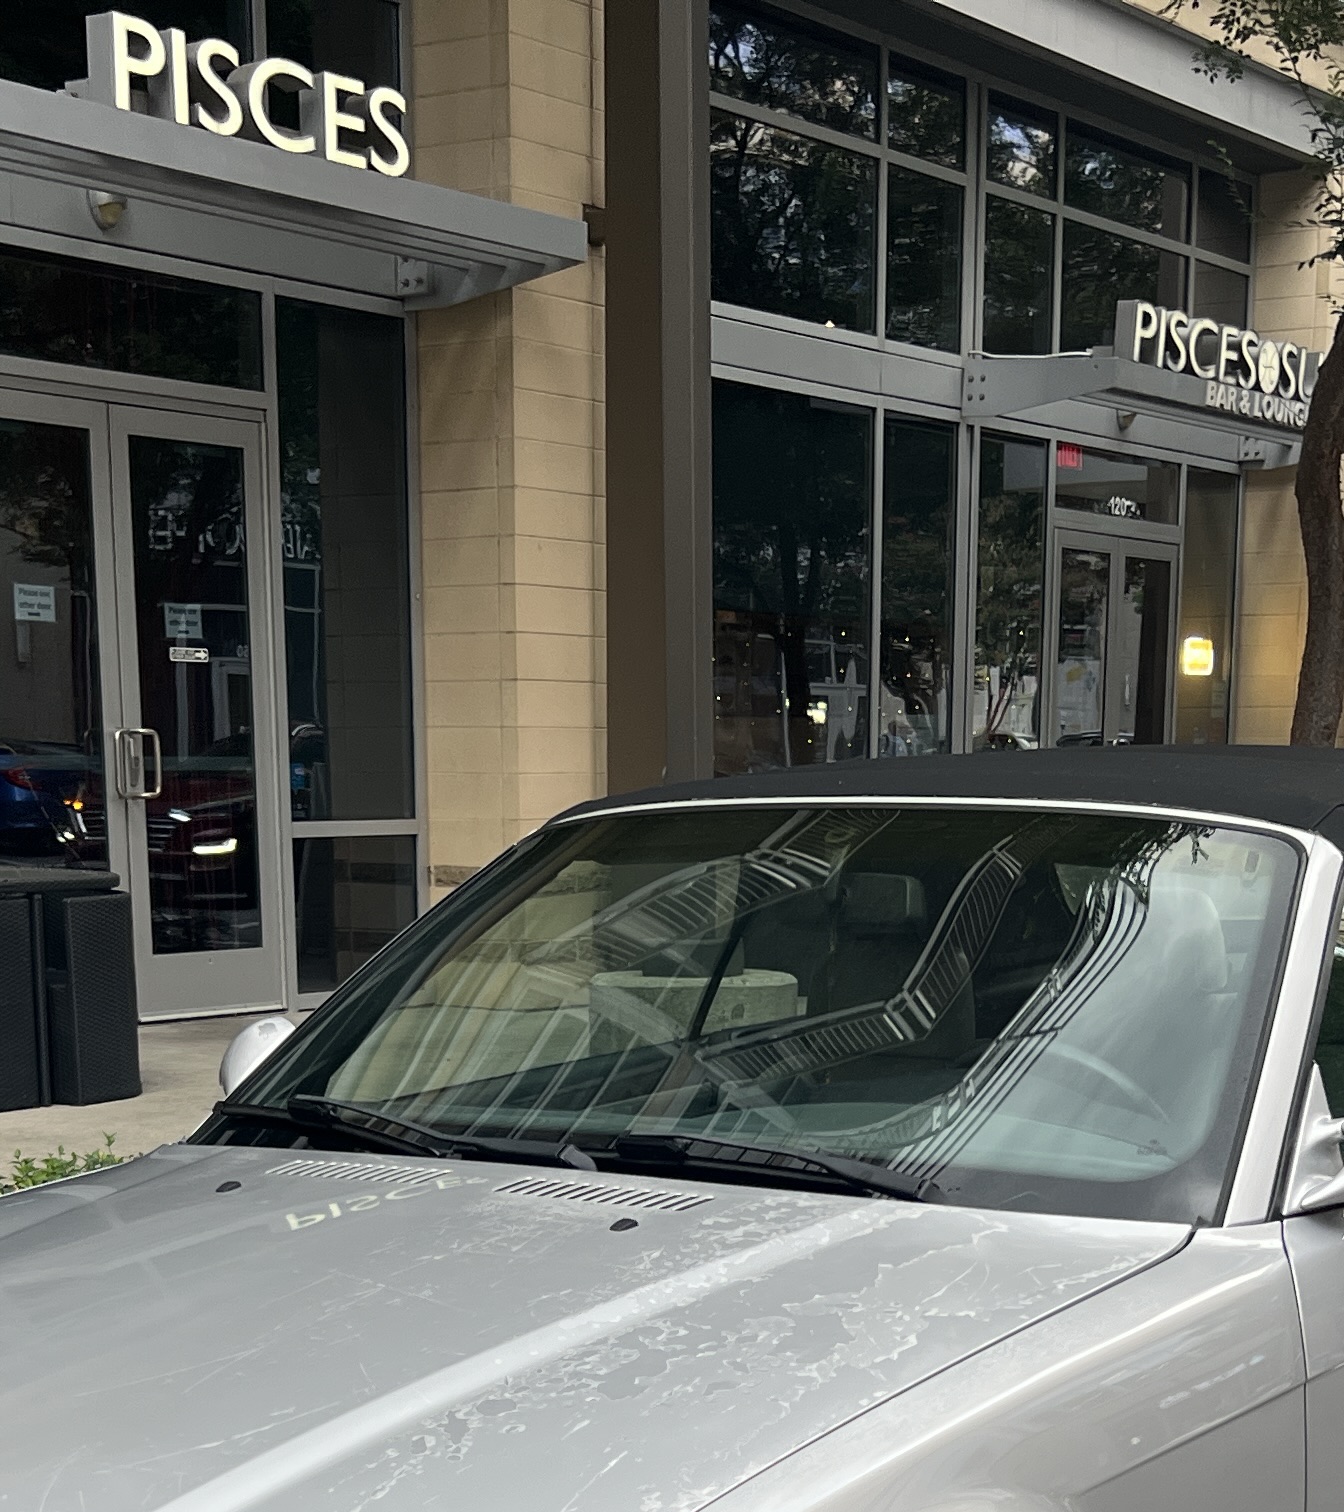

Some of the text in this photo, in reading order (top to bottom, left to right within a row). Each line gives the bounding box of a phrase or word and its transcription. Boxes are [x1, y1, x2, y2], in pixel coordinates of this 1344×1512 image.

[112, 10, 410, 177] PISCES
[1133, 302, 1259, 390] PISCES
[1206, 383, 1308, 427] BAR & LOUNG
